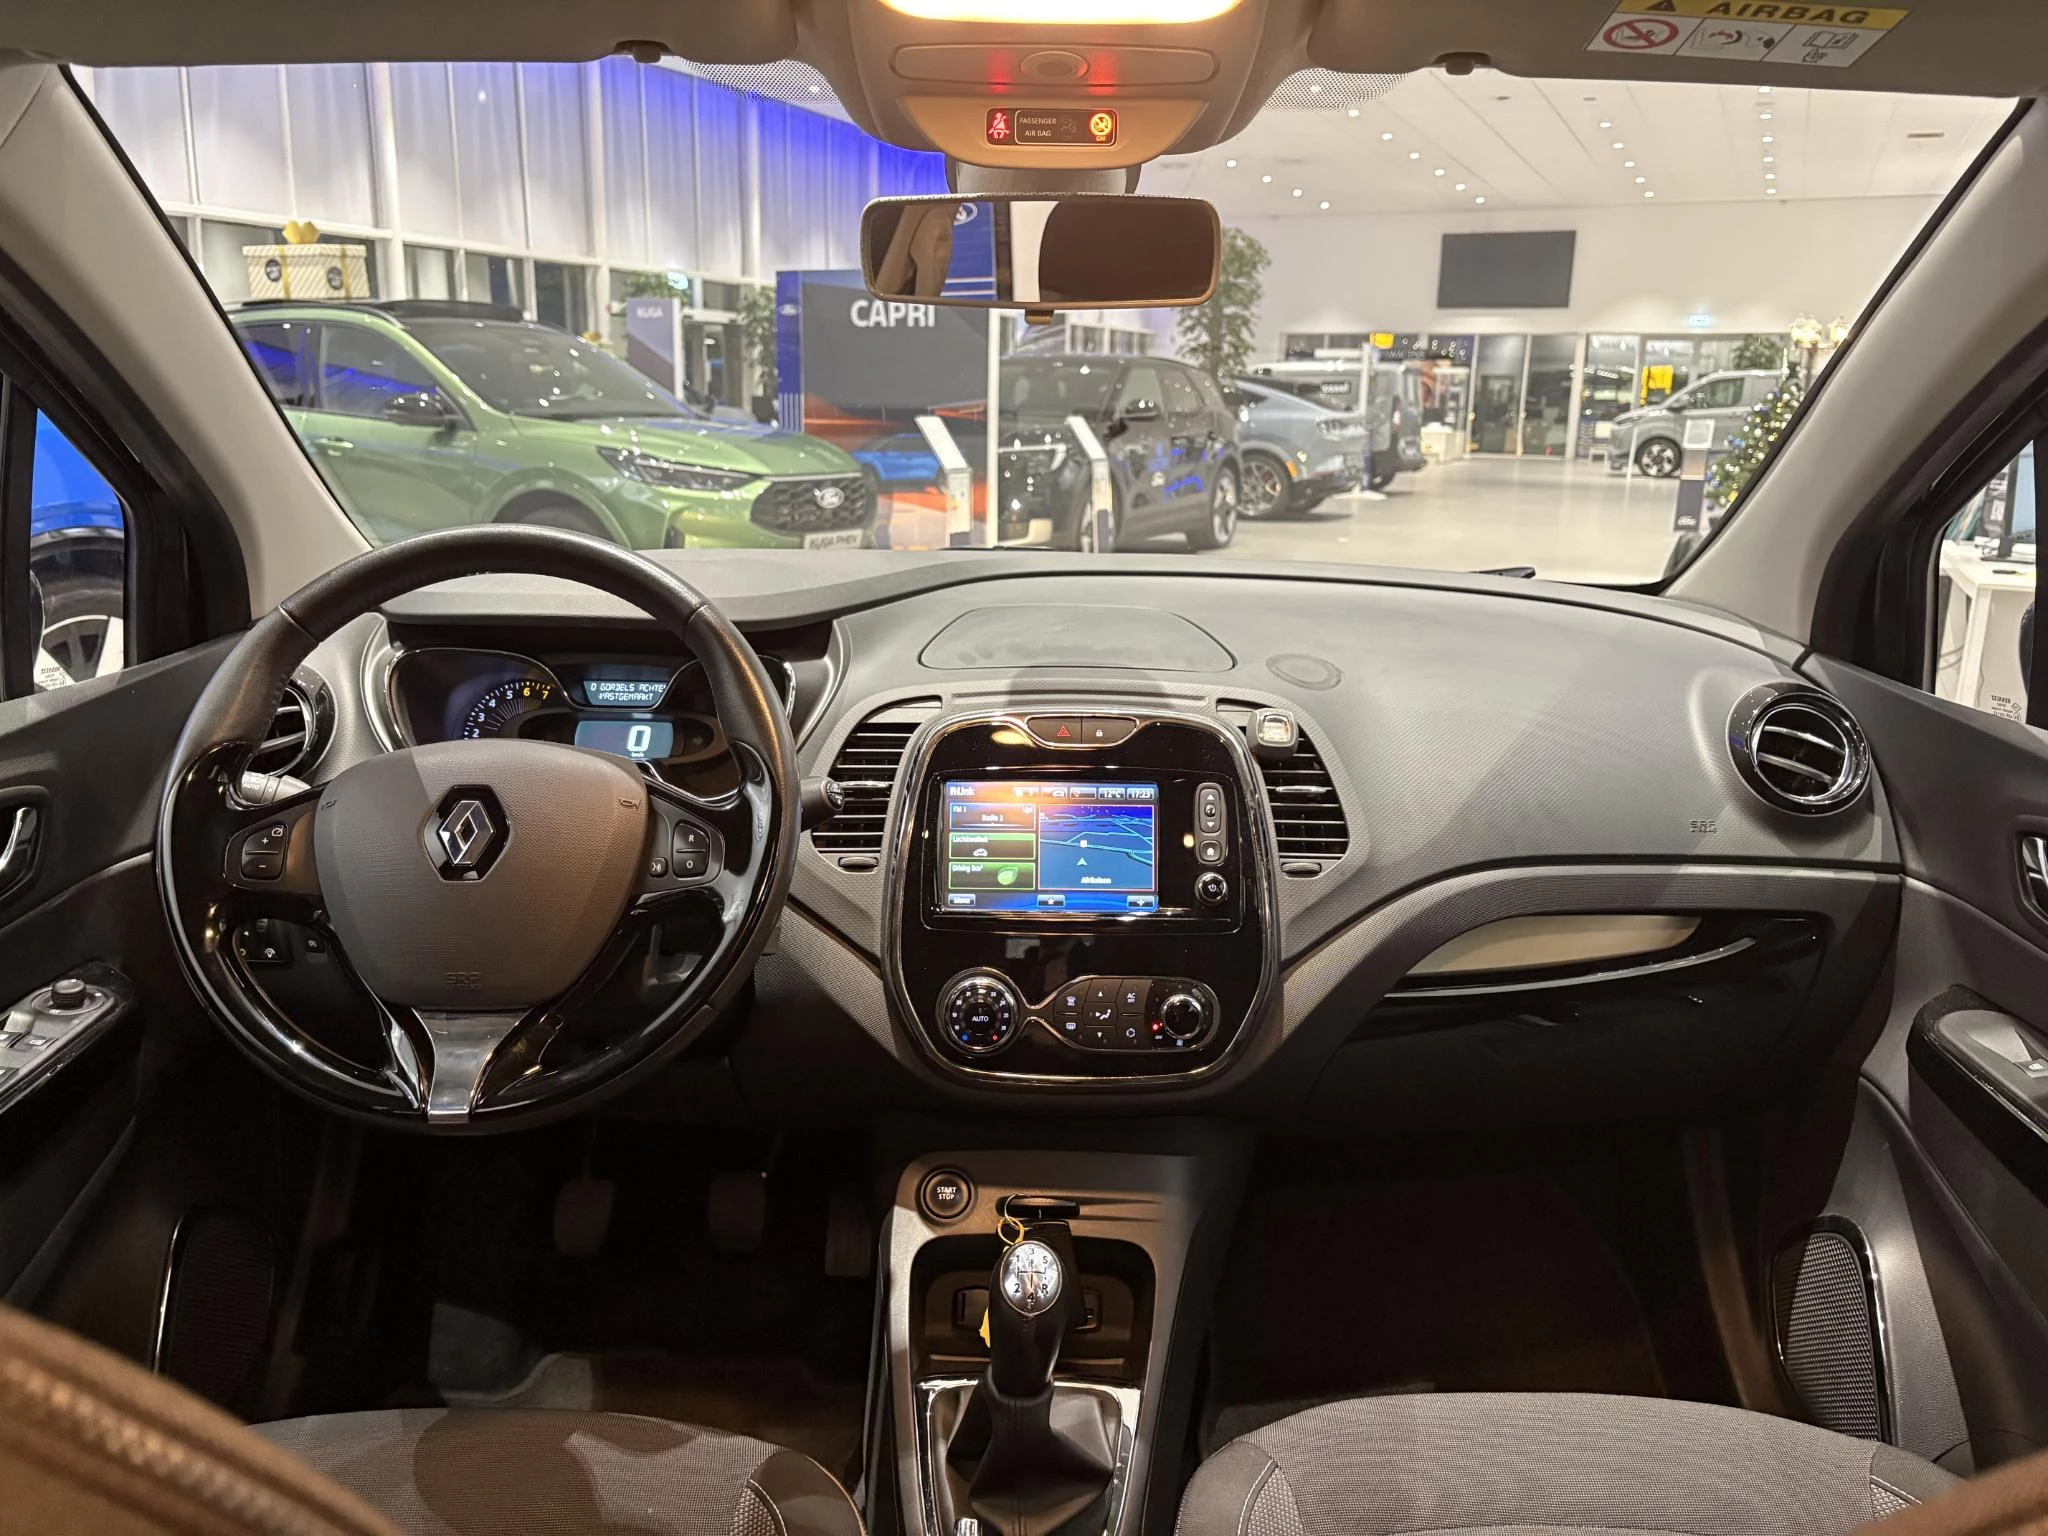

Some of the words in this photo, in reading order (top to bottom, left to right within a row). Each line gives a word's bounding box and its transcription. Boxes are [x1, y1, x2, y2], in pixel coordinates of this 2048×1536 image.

[1706, 2, 1869, 24] AIRBAG
[1020, 117, 1056, 125] PASSENGER
[850, 299, 936, 328] CAPRI
[523, 687, 531, 697] 6
[639, 684, 667, 693] ACHTE
[505, 690, 513, 700] 5
[542, 690, 549, 700] 7
[488, 698, 496, 708] 4
[477, 712, 486, 722] 3
[472, 728, 480, 738] 2
[627, 725, 651, 752] 0
[1131, 789, 1151, 799] 17:23
[688, 834, 695, 843] R
[936, 1186, 957, 1194] START
[1015, 1254, 1020, 1263] 1
[1014, 1282, 1021, 1294] 2
[1041, 1283, 1049, 1295] R
[1027, 1291, 1035, 1301] 4
